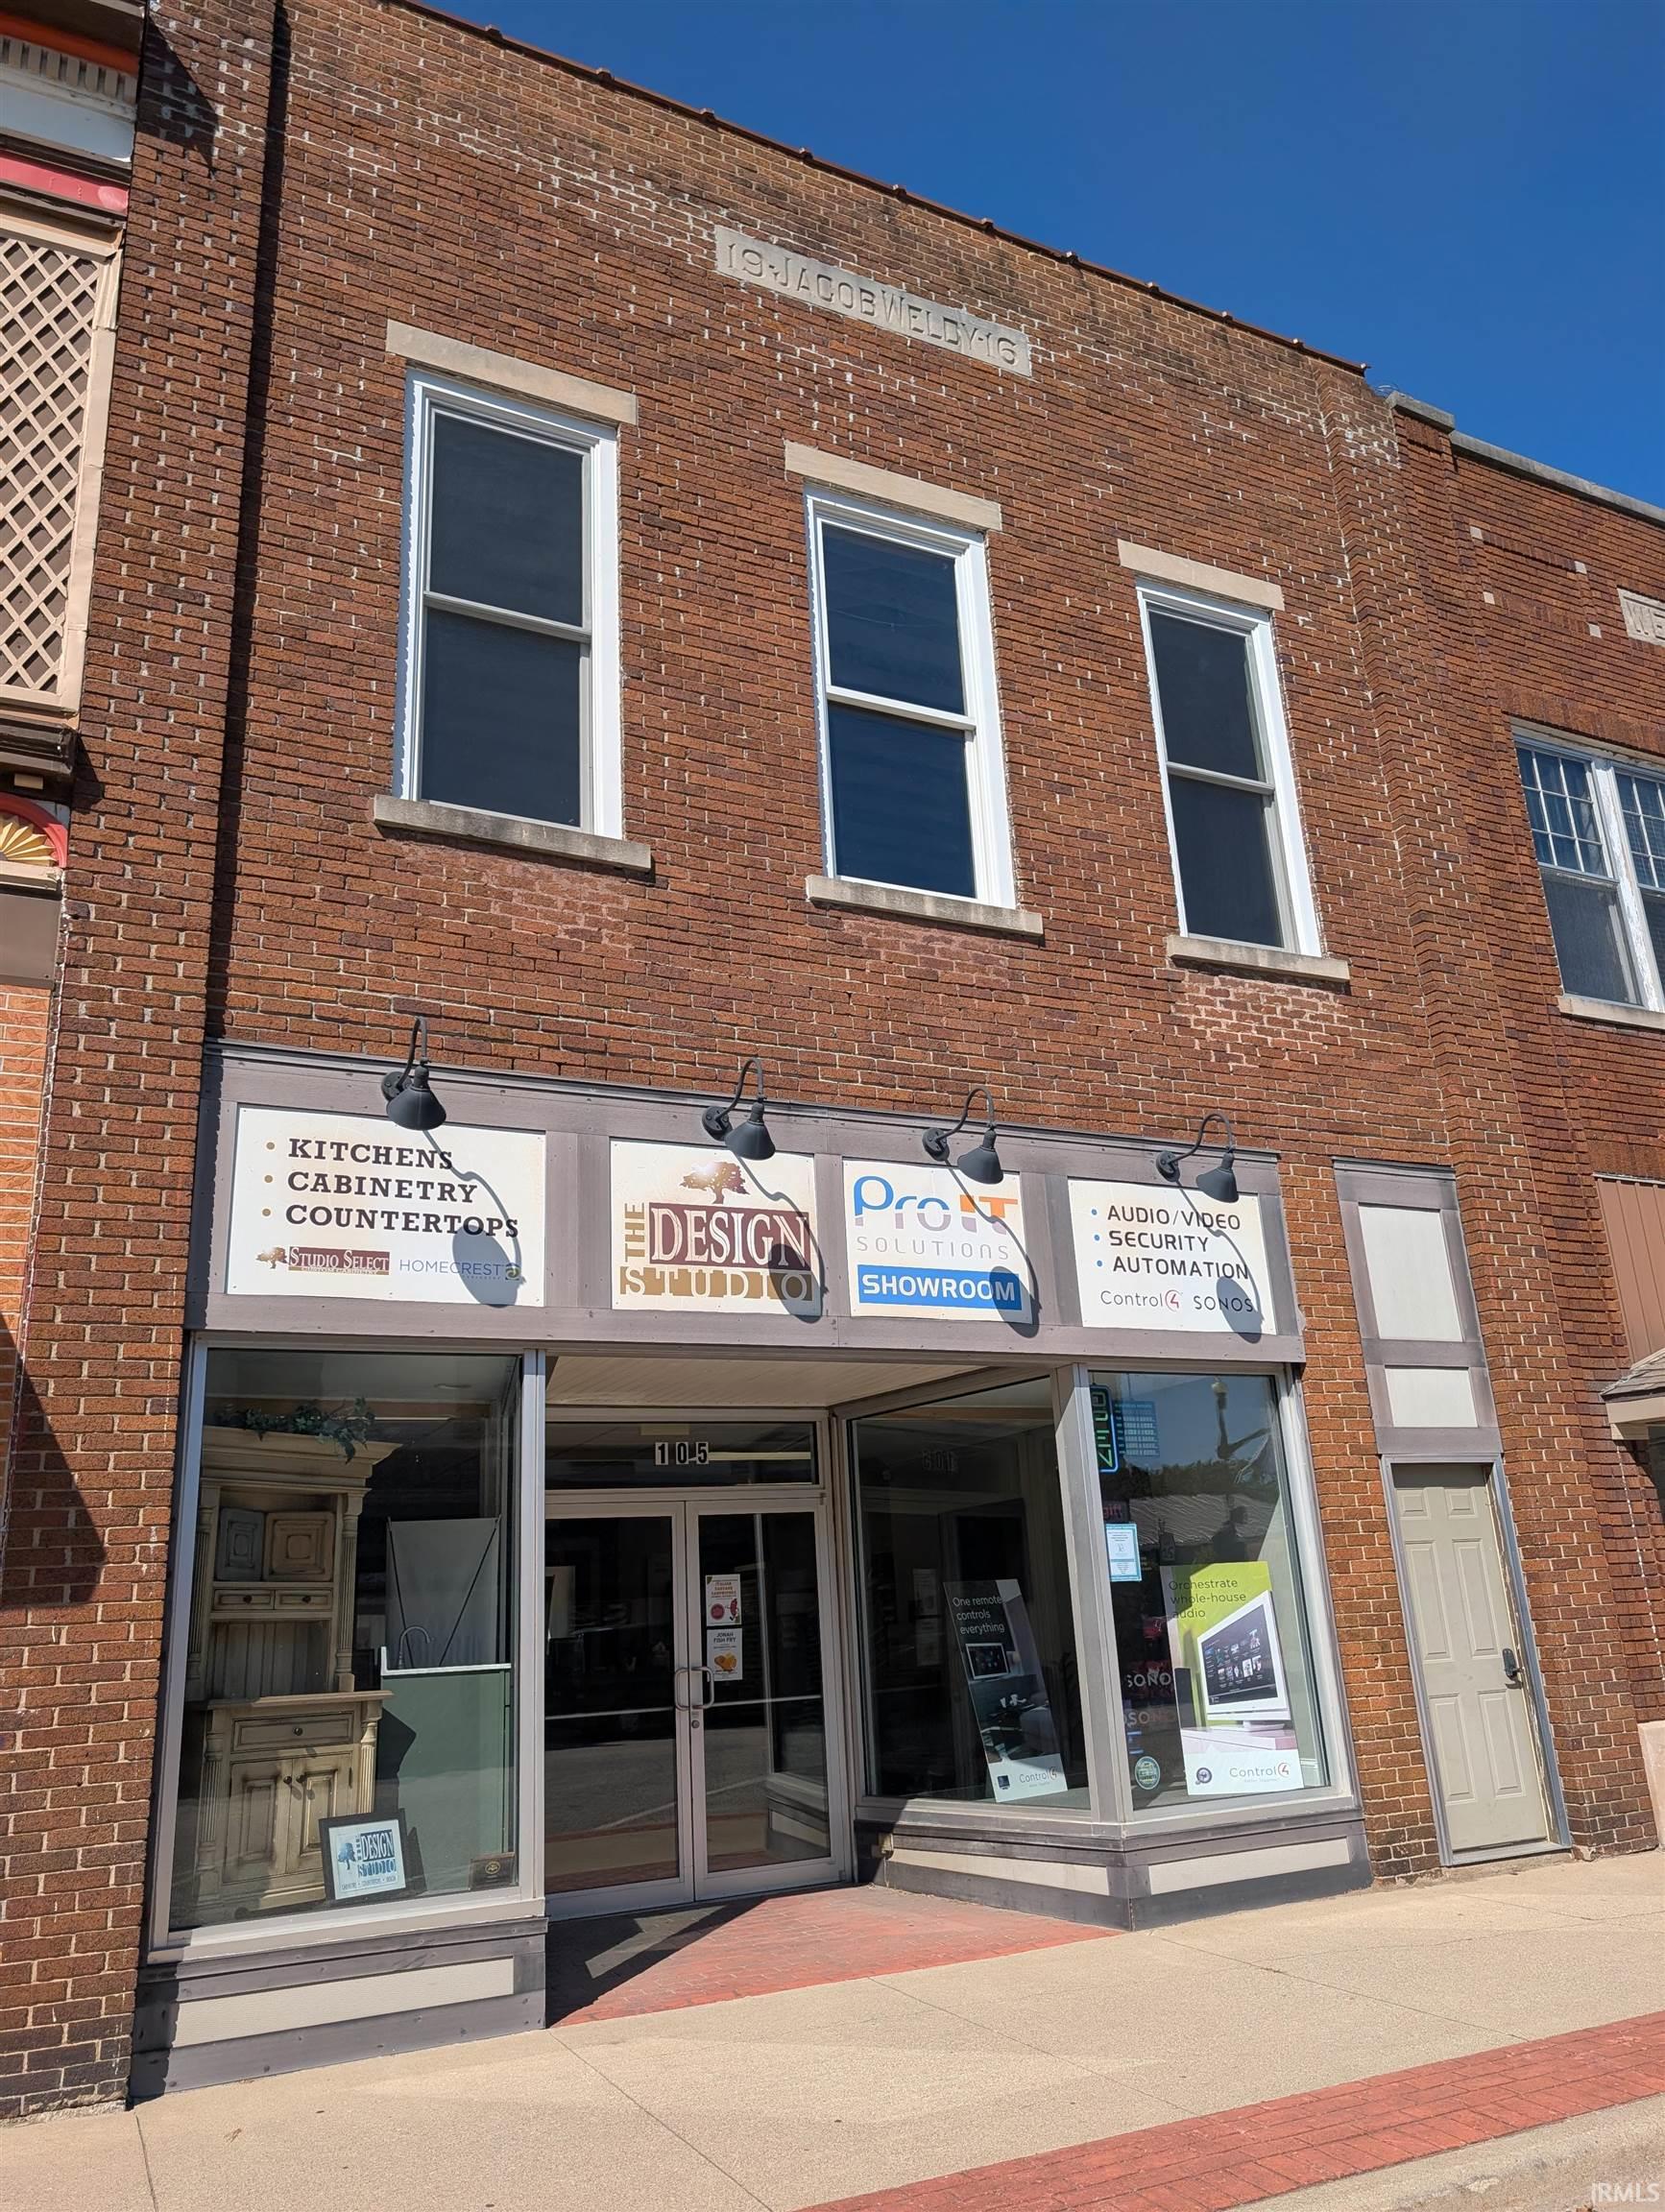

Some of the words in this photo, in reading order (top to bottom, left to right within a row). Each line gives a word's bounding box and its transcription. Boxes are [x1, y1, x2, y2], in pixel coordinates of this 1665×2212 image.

[288, 1138, 452, 1169] KITCHENS
[287, 1171, 477, 1203] CABINETRY
[285, 1204, 519, 1238] COUNTERTOPS
[1107, 1205, 1241, 1230] AUDIO/VIDEO
[624, 1203, 646, 1262] THE
[651, 1208, 808, 1266] DESIGN
[1110, 1231, 1208, 1252] SECURITY
[290, 1247, 339, 1267] STUDIO
[344, 1249, 389, 1270] SELECT
[399, 1260, 501, 1276] HOMECREST
[1113, 1257, 1249, 1280] AUTOMATION
[624, 1266, 808, 1300] STUDIO
[862, 1274, 1015, 1301] SHOWROOM
[1194, 1296, 1253, 1312] SONOS
[657, 1442, 709, 1465] 105
[1169, 1578, 1238, 1591] Orchestrate
[953, 1597, 971, 1608] One
[973, 1596, 1002, 1606] remote
[1170, 1593, 1246, 1604] whole-house
[956, 1610, 991, 1621] controls
[1172, 1607, 1206, 1619] audio
[960, 1623, 1005, 1635] everything
[361, 1831, 395, 1860] DESIGN
[358, 1860, 397, 1877] STUDIO
